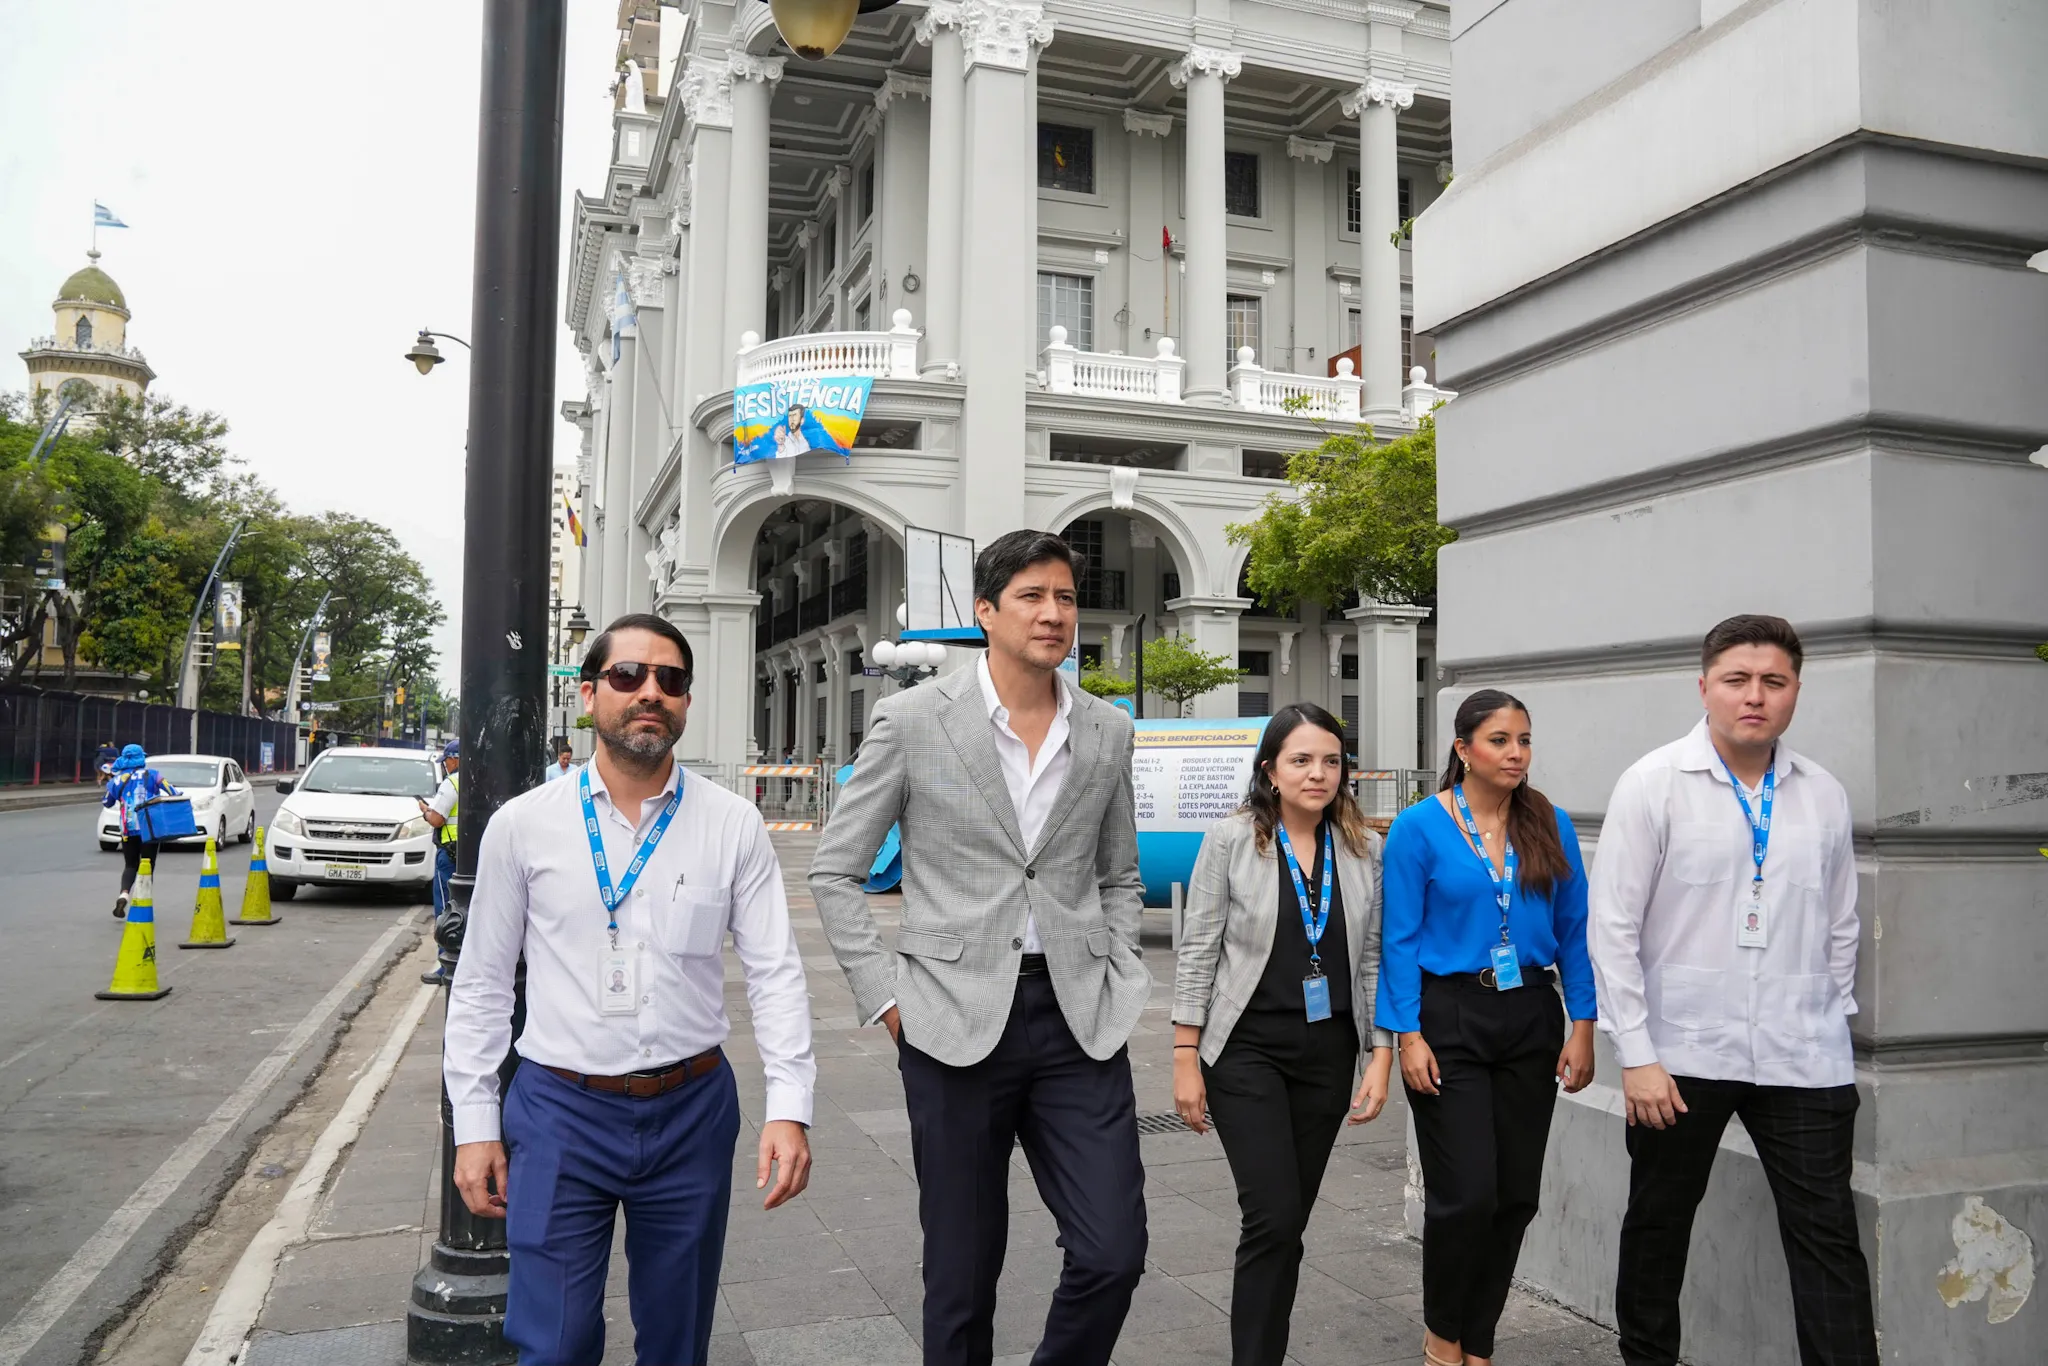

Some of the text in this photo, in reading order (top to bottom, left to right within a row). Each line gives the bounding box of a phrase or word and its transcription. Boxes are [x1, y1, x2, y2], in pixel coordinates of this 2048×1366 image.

[736, 384, 863, 423] RESISTENCIA
[1167, 734, 1248, 742] BENEFICIADOS
[1178, 802, 1239, 810] LOTES POPULARES
[1178, 811, 1197, 819] SOCIO
[328, 870, 362, 879] GMA-1285
